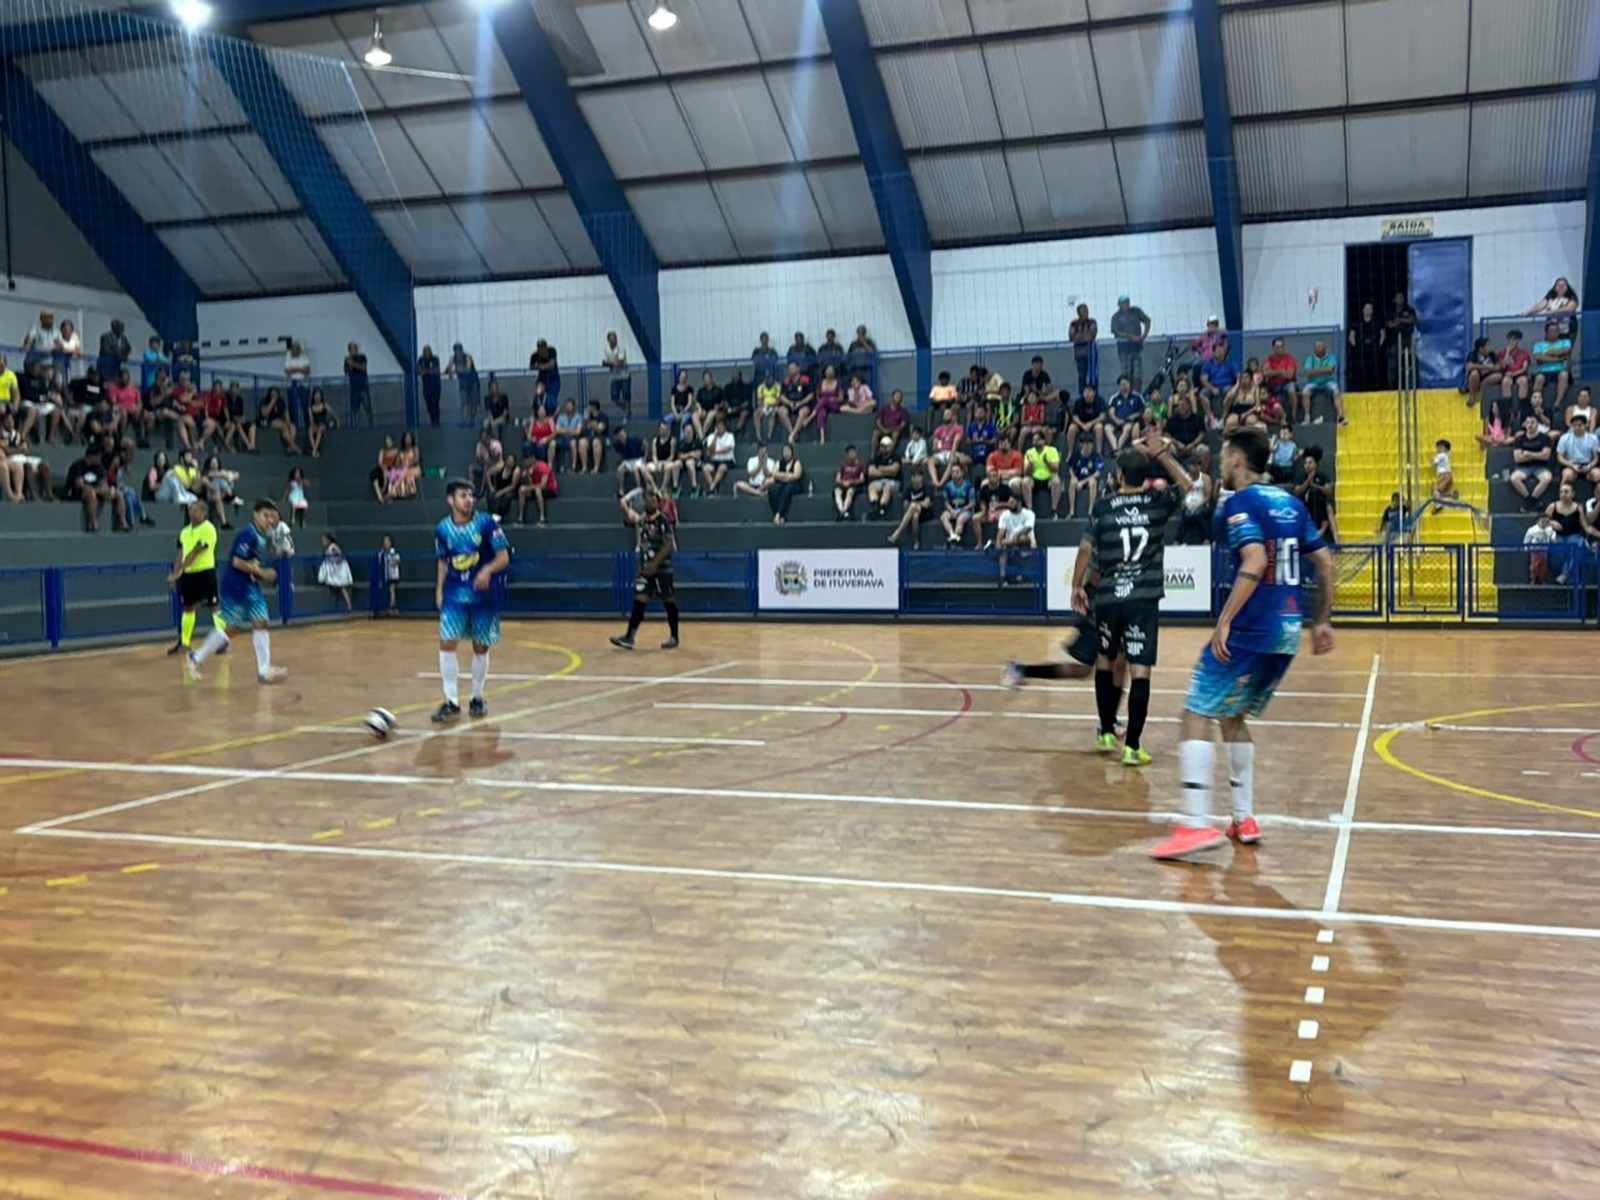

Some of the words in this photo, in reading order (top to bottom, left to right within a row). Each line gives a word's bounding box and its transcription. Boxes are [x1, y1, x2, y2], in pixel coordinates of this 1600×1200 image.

[1119, 526, 1149, 562] 17
[813, 568, 875, 578] PREFEITURA
[813, 579, 826, 588] DE
[829, 578, 885, 588] ITUVERAVA
